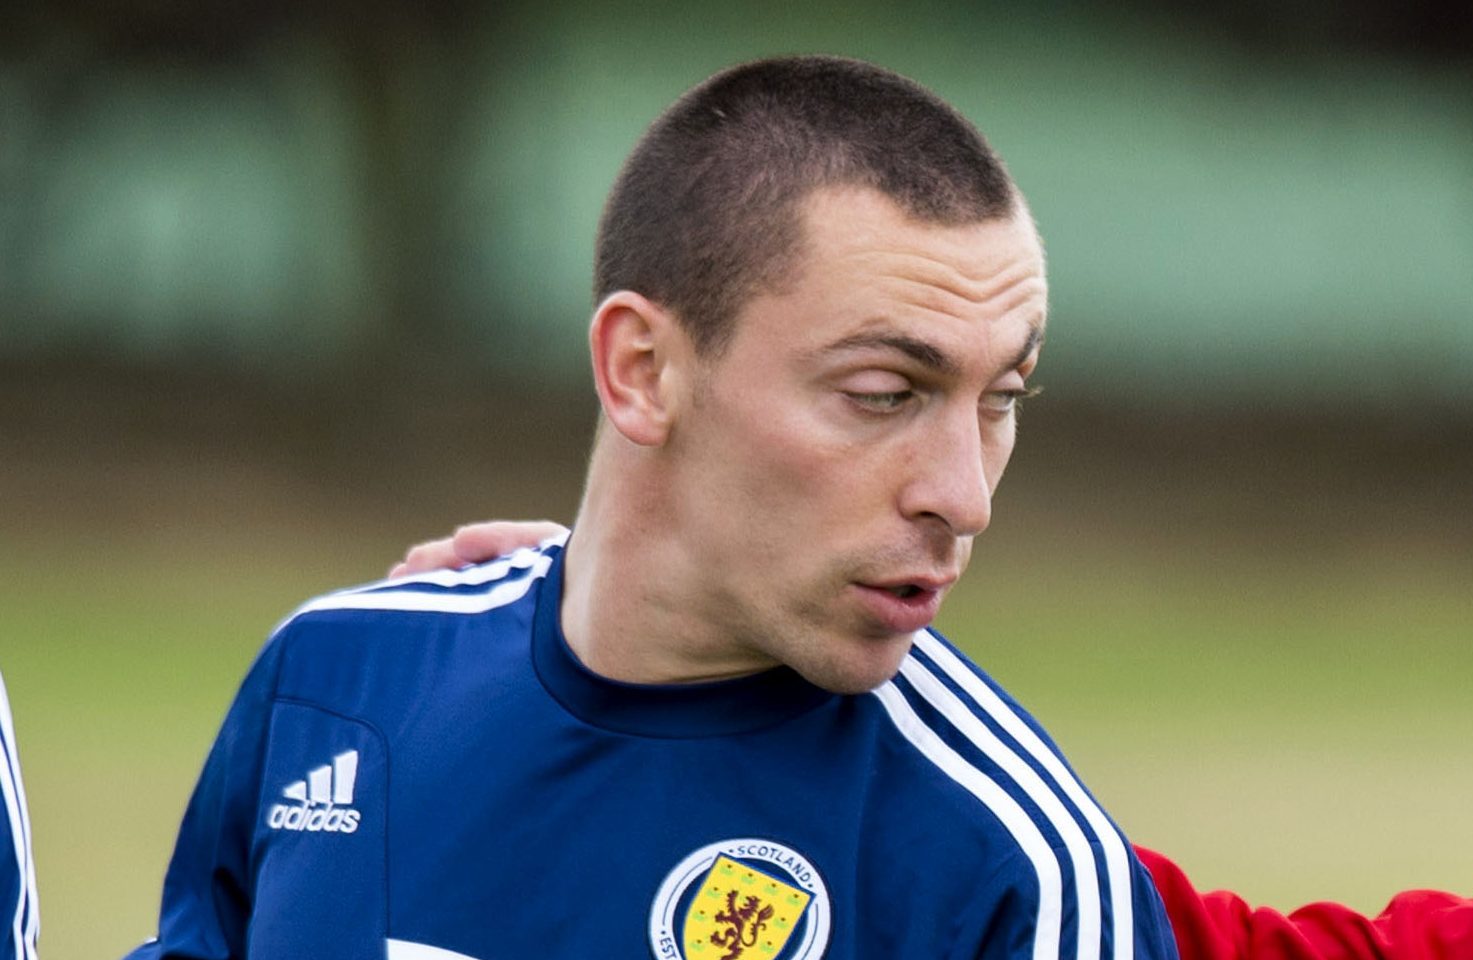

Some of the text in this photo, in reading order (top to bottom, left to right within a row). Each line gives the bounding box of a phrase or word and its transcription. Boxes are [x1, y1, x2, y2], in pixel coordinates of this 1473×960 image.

[266, 799, 361, 833] adidas
[737, 845, 811, 883] SCOTLAND
[659, 936, 677, 960] EST
